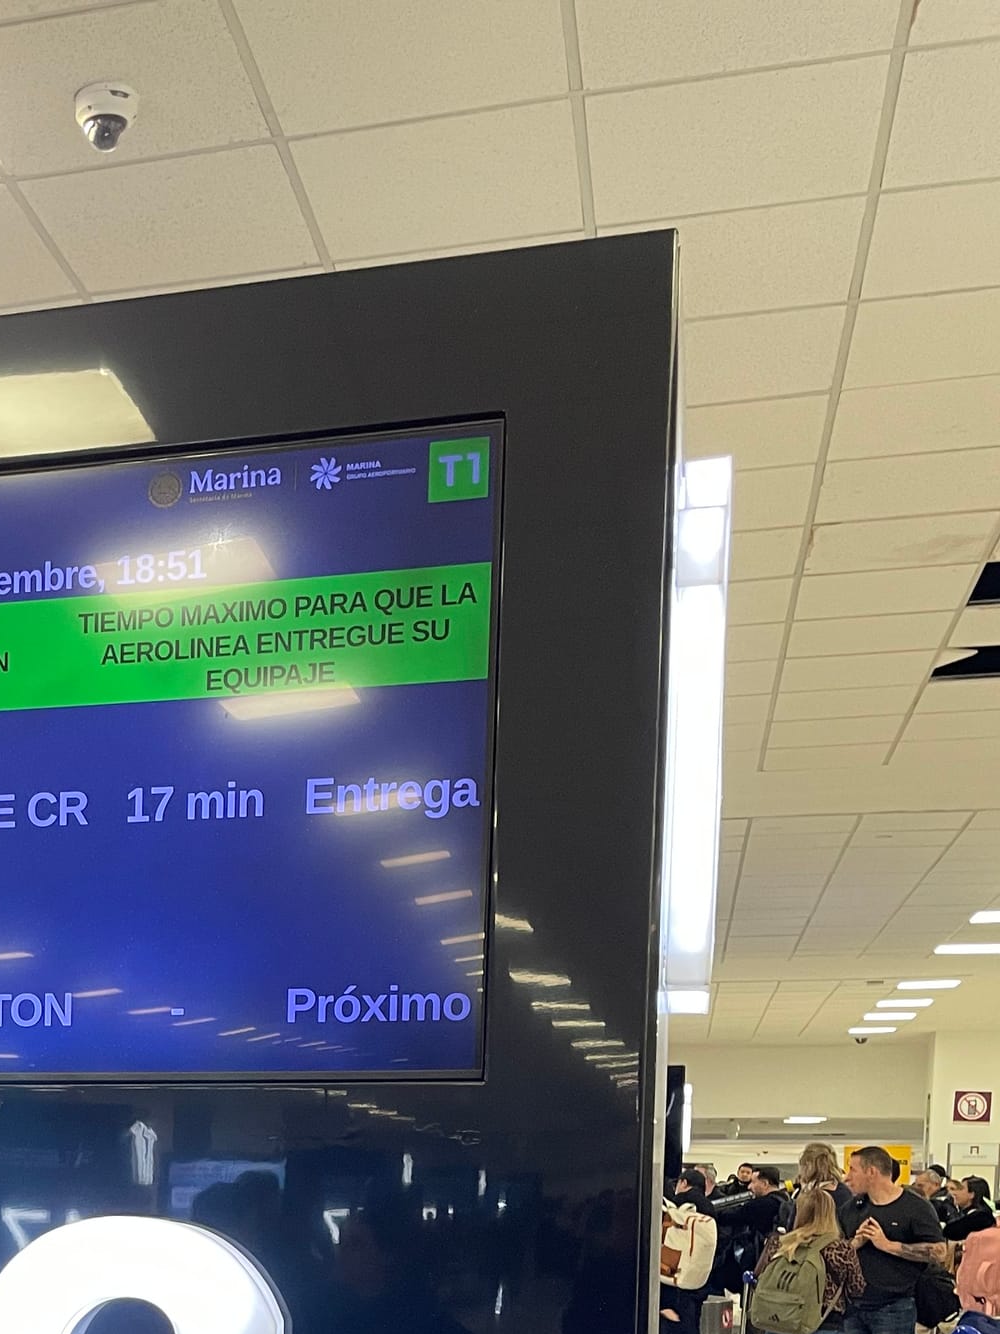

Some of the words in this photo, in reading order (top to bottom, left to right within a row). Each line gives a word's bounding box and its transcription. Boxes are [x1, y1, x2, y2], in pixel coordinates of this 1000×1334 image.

[189, 464, 282, 494] Marina
[346, 460, 382, 471] MARINA
[439, 452, 481, 487] T1
[116, 550, 207, 586] 18:51
[79, 601, 174, 635] TIEMPO
[180, 597, 288, 628] MAXIMO
[294, 592, 367, 619] PARA
[374, 586, 434, 615] QUE
[440, 581, 477, 607] LA
[101, 633, 249, 666] AEROLINEA
[256, 622, 406, 655] ENTREGUE
[412, 617, 450, 643] SU
[206, 661, 336, 692] EQUIPAJE
[27, 790, 88, 827] CR
[127, 785, 175, 823] 17
[186, 781, 265, 820] min
[305, 776, 480, 819] Entrega
[286, 984, 471, 1024] Próximo
